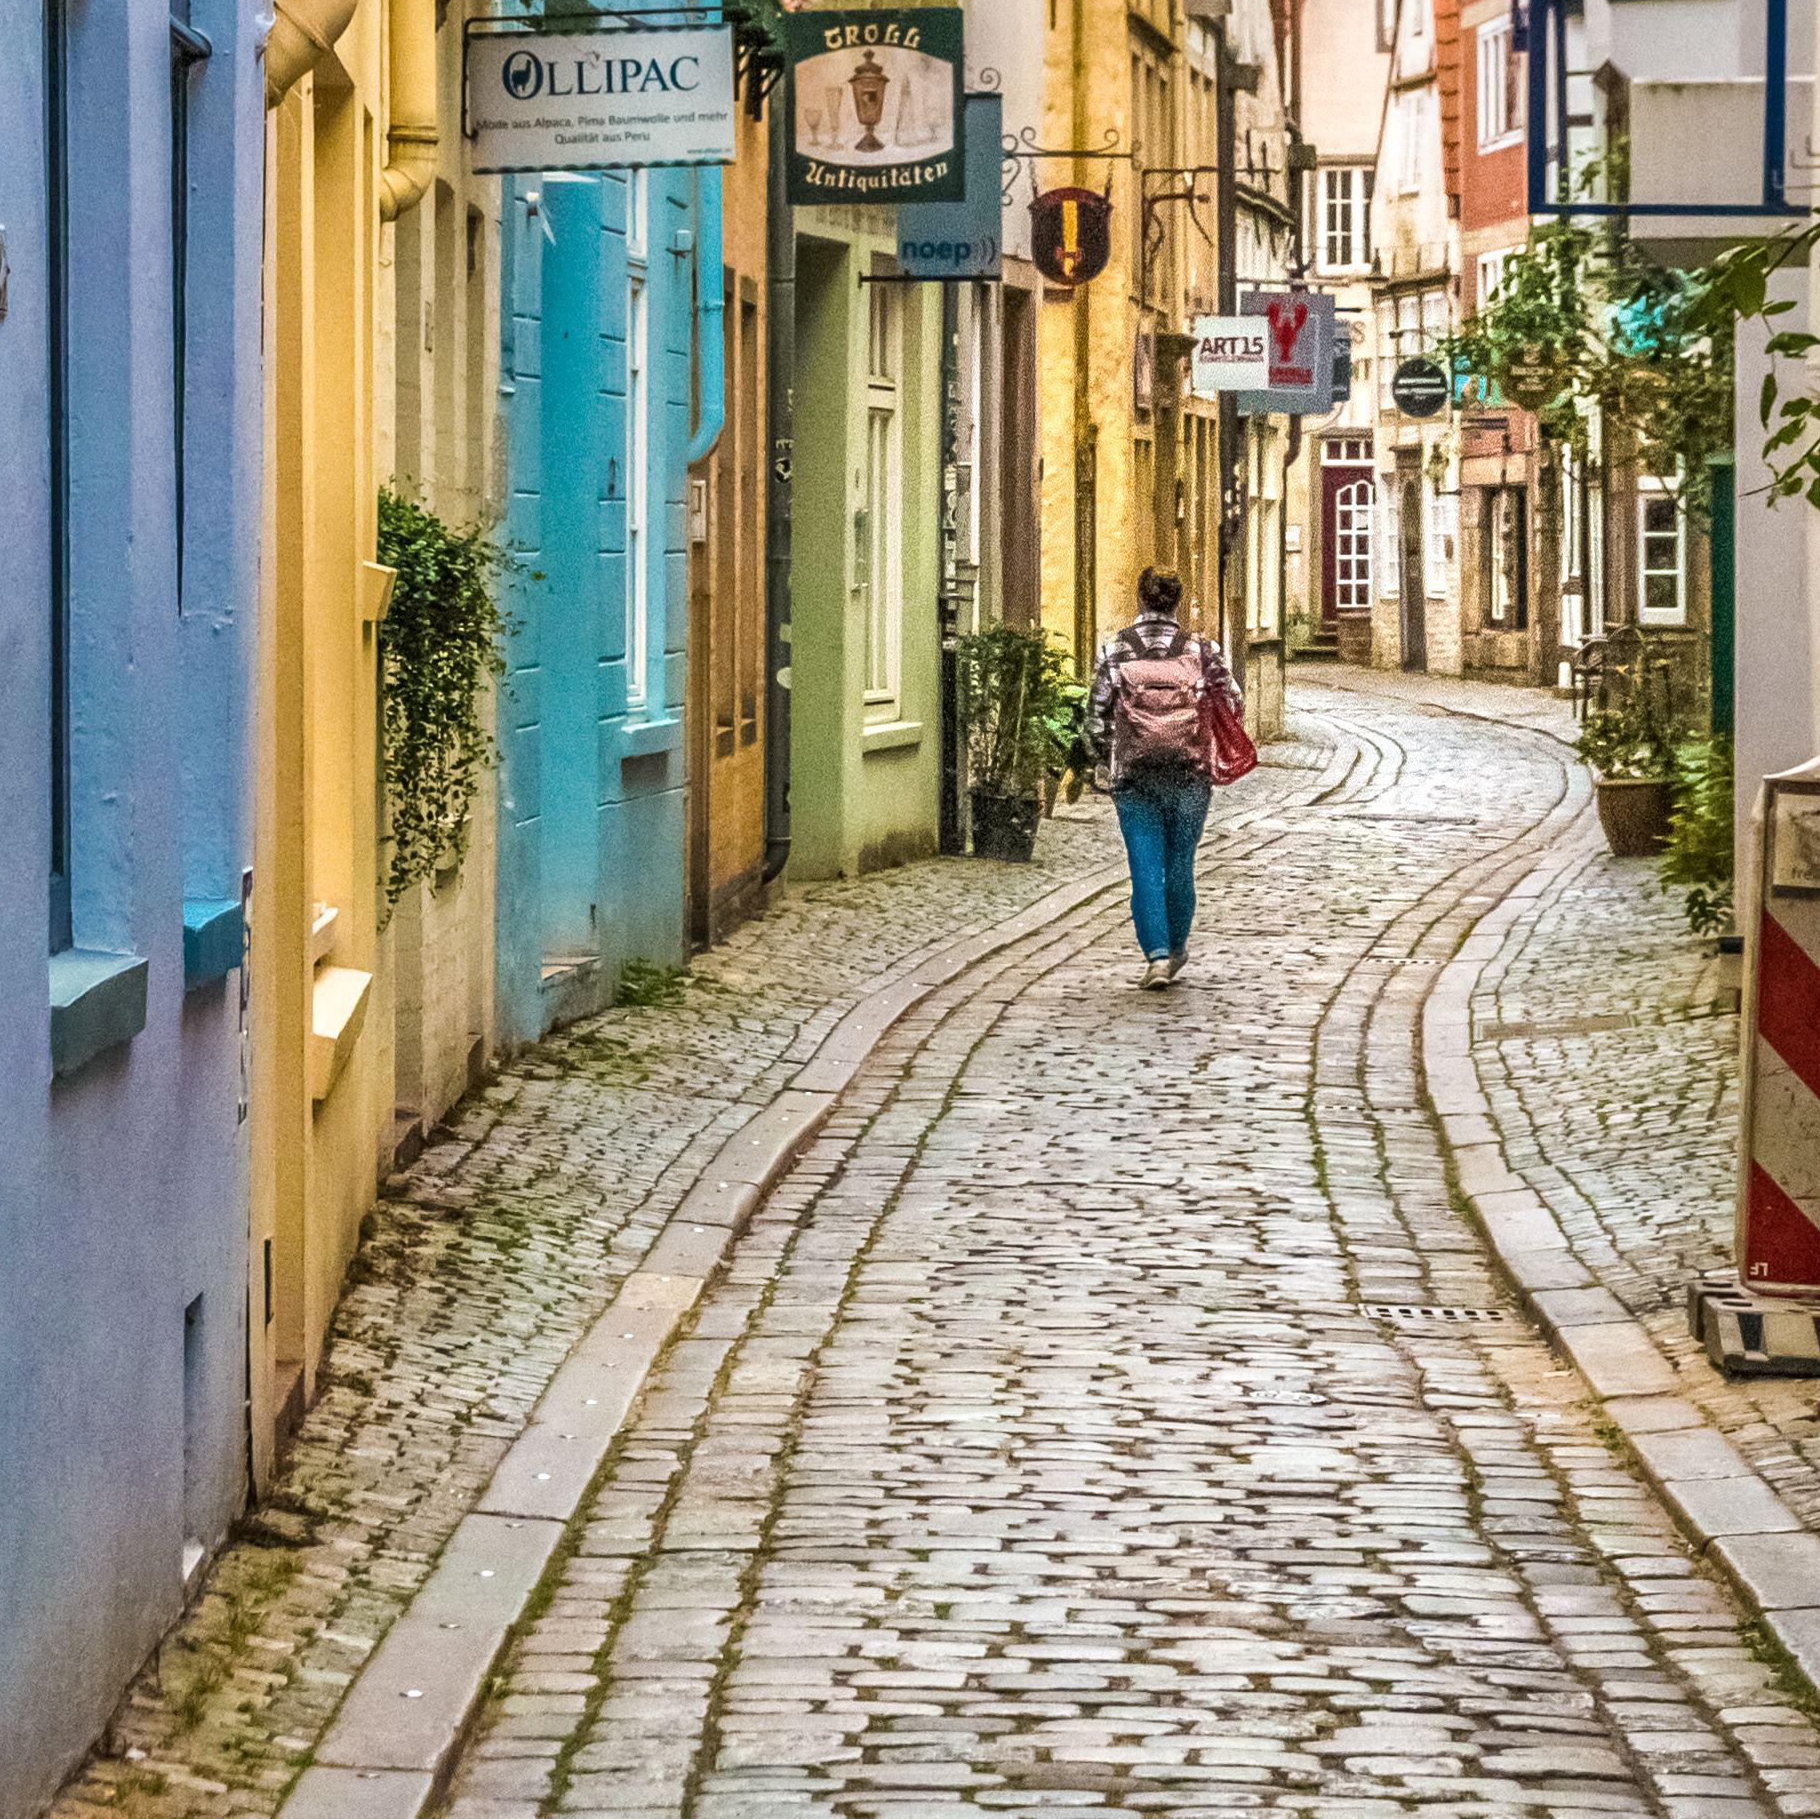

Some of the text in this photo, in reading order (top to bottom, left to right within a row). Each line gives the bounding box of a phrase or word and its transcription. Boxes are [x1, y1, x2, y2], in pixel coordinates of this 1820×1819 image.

[823, 23, 921, 50] TROLL
[502, 49, 700, 101] OLLIPAC
[512, 119, 531, 129] aus
[578, 116, 605, 127] Pima
[608, 113, 671, 126] Baumwolle
[674, 111, 695, 123] und
[698, 110, 729, 122] mehr
[554, 131, 650, 145] Qualität aus Peru
[901, 240, 971, 267] noep
